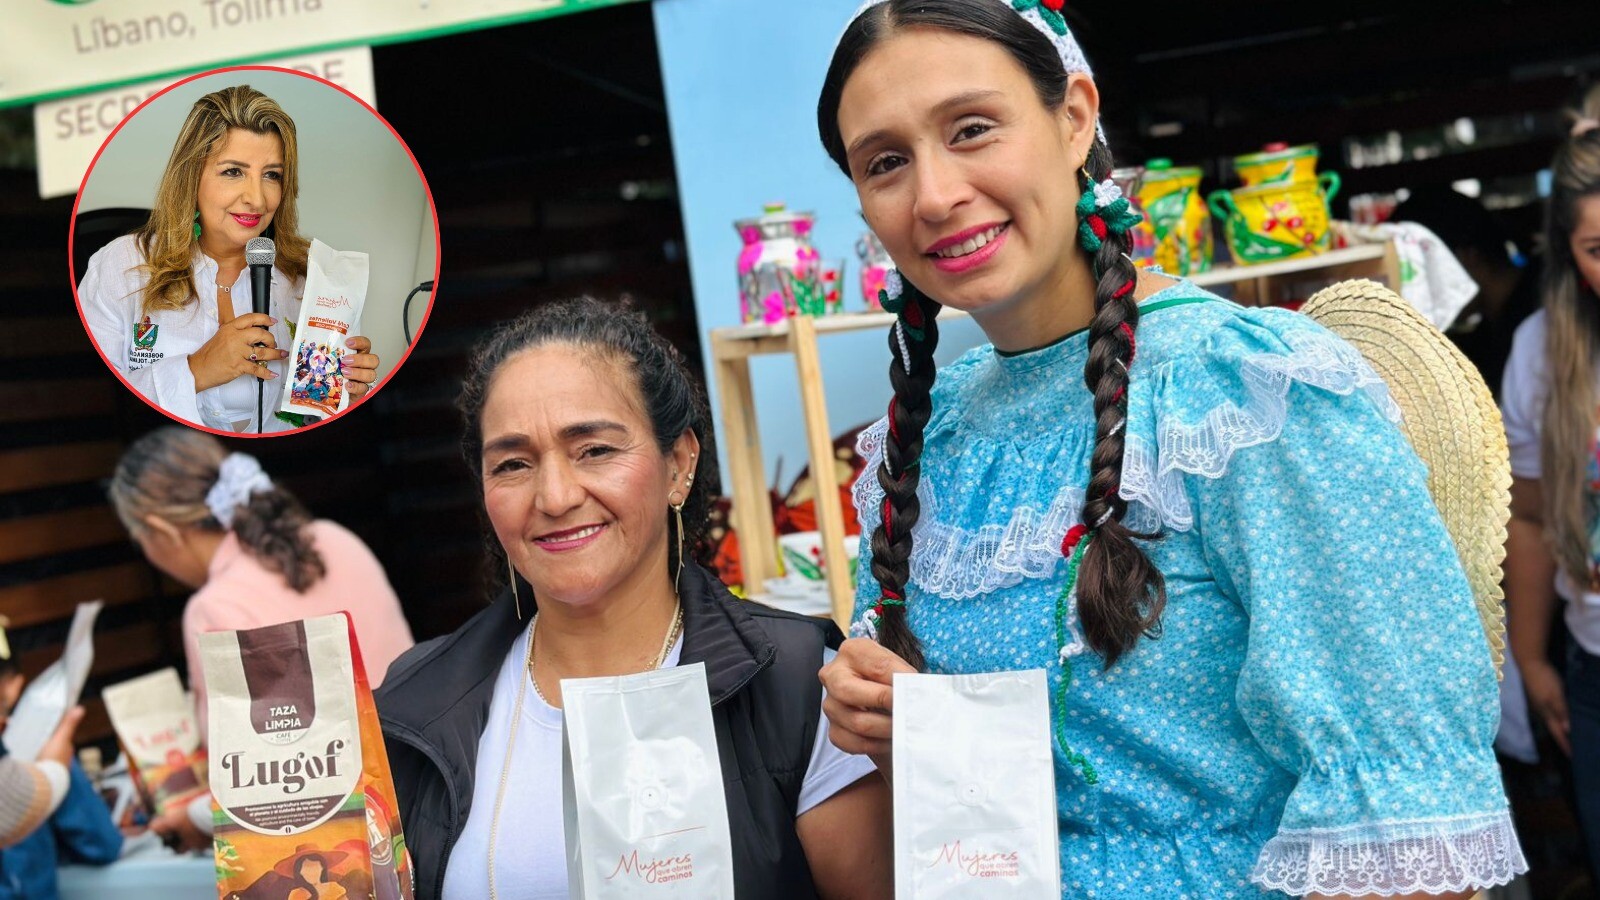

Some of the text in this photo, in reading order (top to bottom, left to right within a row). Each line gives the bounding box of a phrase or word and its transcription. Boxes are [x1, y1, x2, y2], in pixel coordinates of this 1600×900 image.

[72, 12, 196, 54] Líbano,
[270, 704, 297, 717] TAZA
[265, 717, 302, 731] LIMPIA
[221, 739, 344, 794] Lugof
[927, 840, 1017, 876] Mujeres
[605, 850, 691, 884] Mujeres
[657, 868, 671, 877] que
[980, 869, 1019, 877] caminos
[657, 870, 693, 883] caminos
